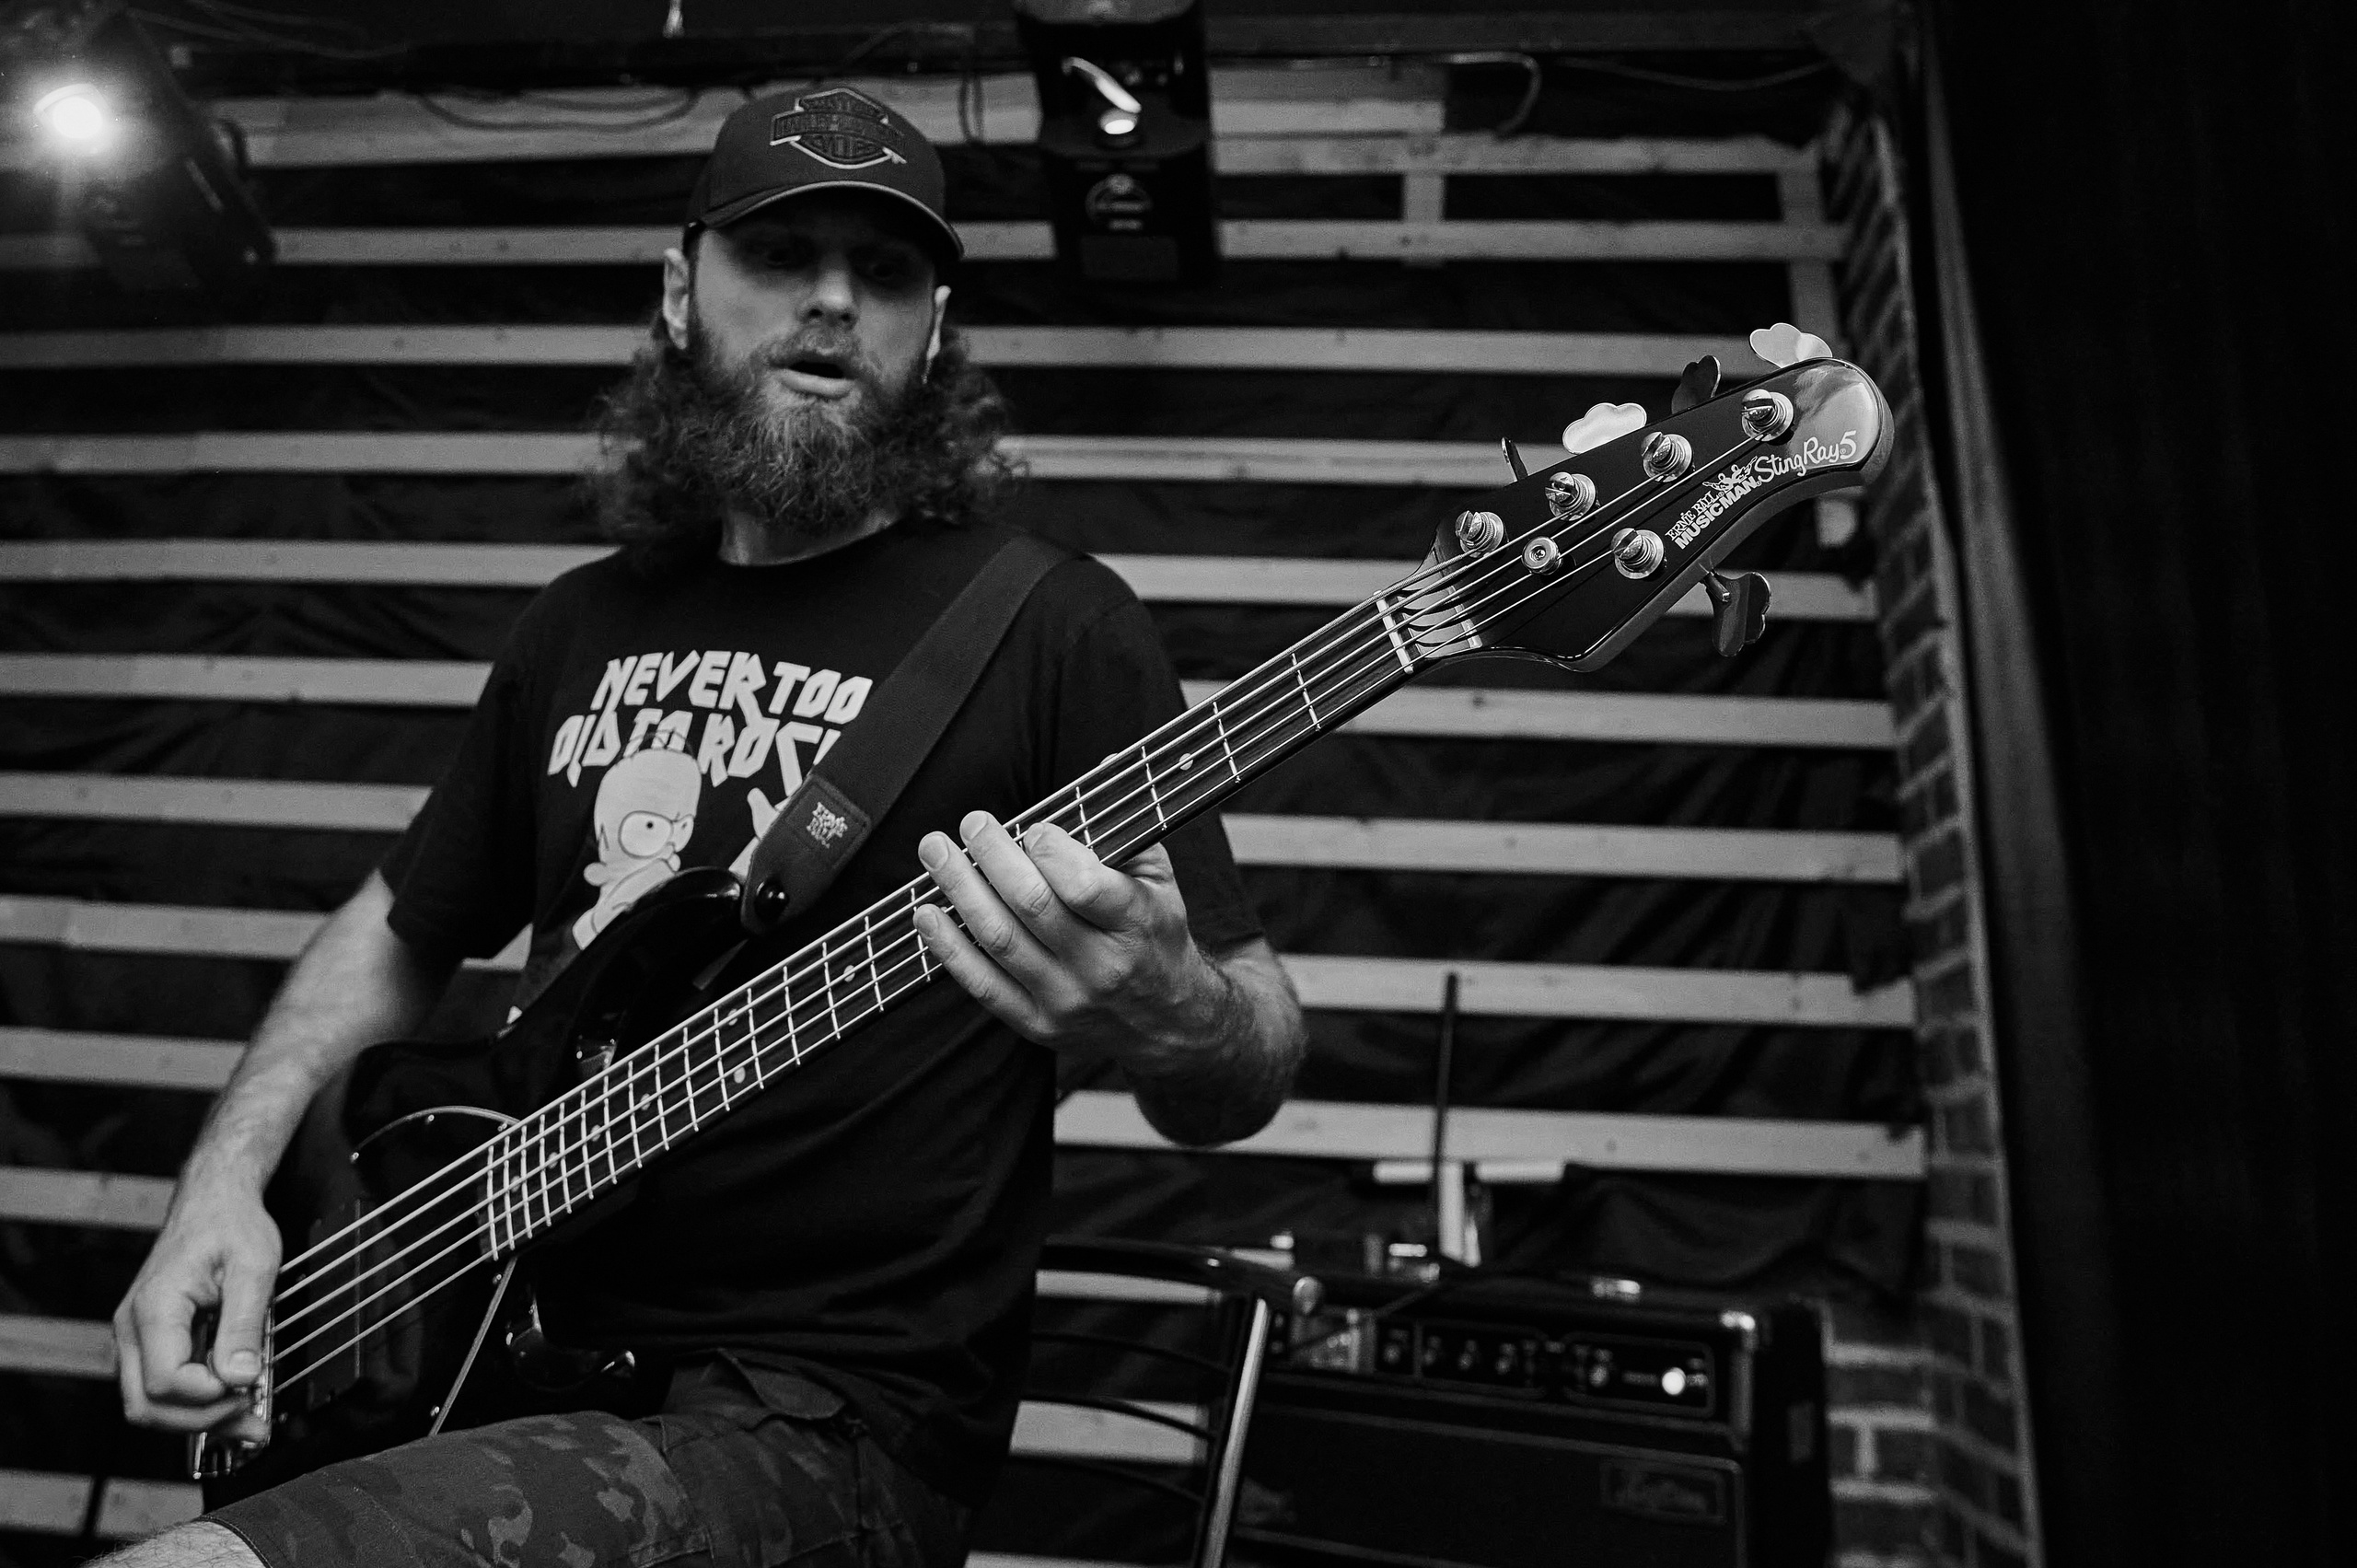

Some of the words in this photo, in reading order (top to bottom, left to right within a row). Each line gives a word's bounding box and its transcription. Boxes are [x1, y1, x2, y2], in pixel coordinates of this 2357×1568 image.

[1665, 510, 1697, 541] ERNIE
[1691, 491, 1720, 517] BALL
[590, 649, 767, 726] NEVER
[768, 661, 874, 725] TOO
[547, 711, 621, 788] OLD
[697, 713, 842, 797] ROC
